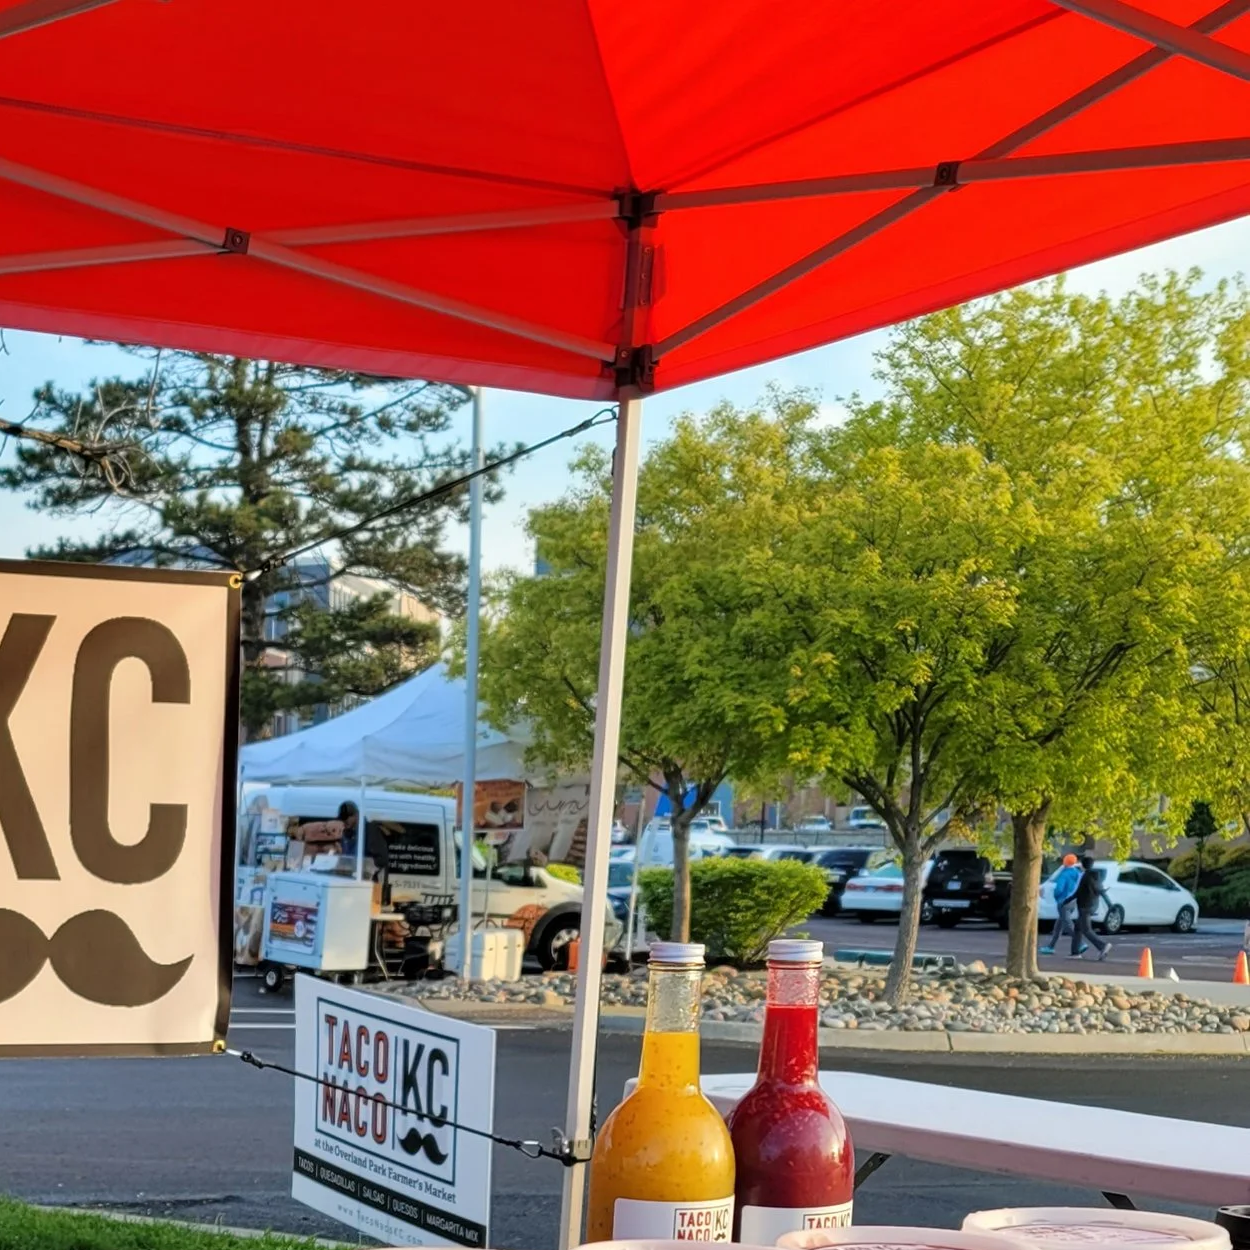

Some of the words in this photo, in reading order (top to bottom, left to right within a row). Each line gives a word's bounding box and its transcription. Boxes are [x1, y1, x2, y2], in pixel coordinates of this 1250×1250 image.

[407, 843, 434, 853] delicious
[413, 854, 436, 863] healthy
[324, 1014, 389, 1084] TACO
[401, 1039, 449, 1128] KC
[322, 1072, 388, 1144] NACO
[314, 1137, 322, 1148] at
[322, 1140, 334, 1152] the
[334, 1146, 368, 1170] Overland
[368, 1159, 387, 1176] Park
[388, 1167, 423, 1192] Farmer's
[424, 1181, 457, 1204] Market
[298, 1156, 314, 1174] TACOS
[319, 1166, 356, 1193] QUESADILLAS
[362, 1185, 385, 1205] SALSAS
[392, 1198, 419, 1219] QUESOS
[426, 1213, 464, 1237] MARGARITA
[465, 1228, 480, 1243] MIX
[679, 1211, 712, 1228] TACO
[715, 1209, 729, 1231] KC
[807, 1216, 837, 1229] TACO
[677, 1229, 711, 1241] NACO
